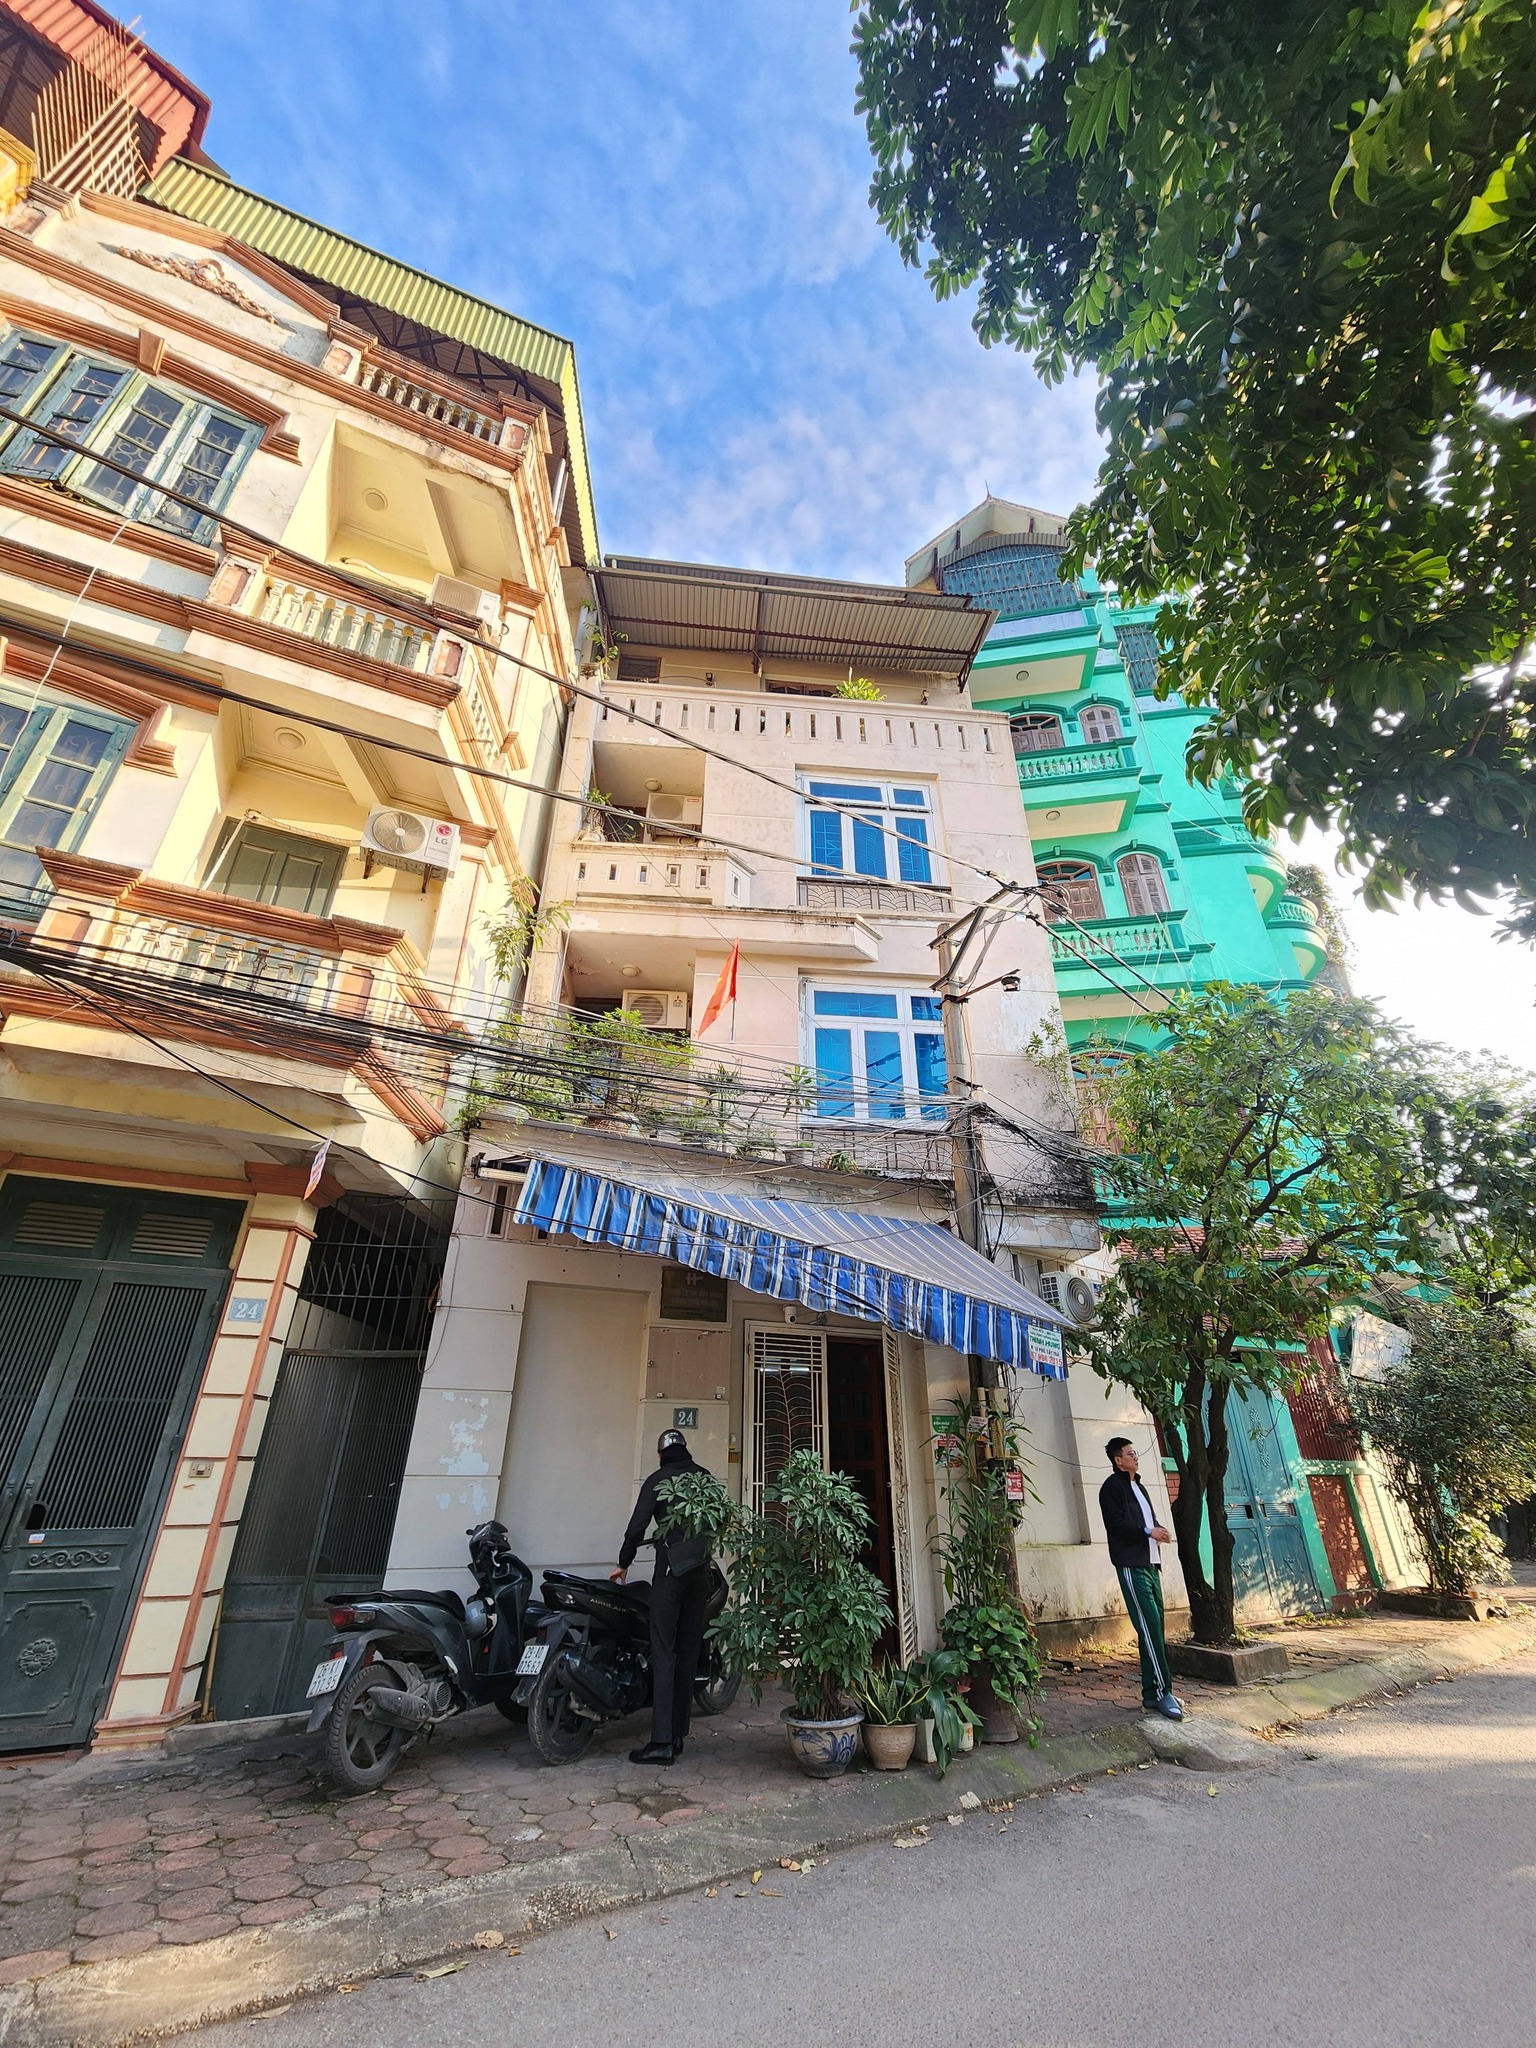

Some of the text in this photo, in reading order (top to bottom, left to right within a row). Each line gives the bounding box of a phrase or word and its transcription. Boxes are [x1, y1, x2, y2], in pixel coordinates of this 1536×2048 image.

[435, 836, 449, 846] LG
[235, 1302, 259, 1319] 24
[678, 1411, 694, 1426] 24
